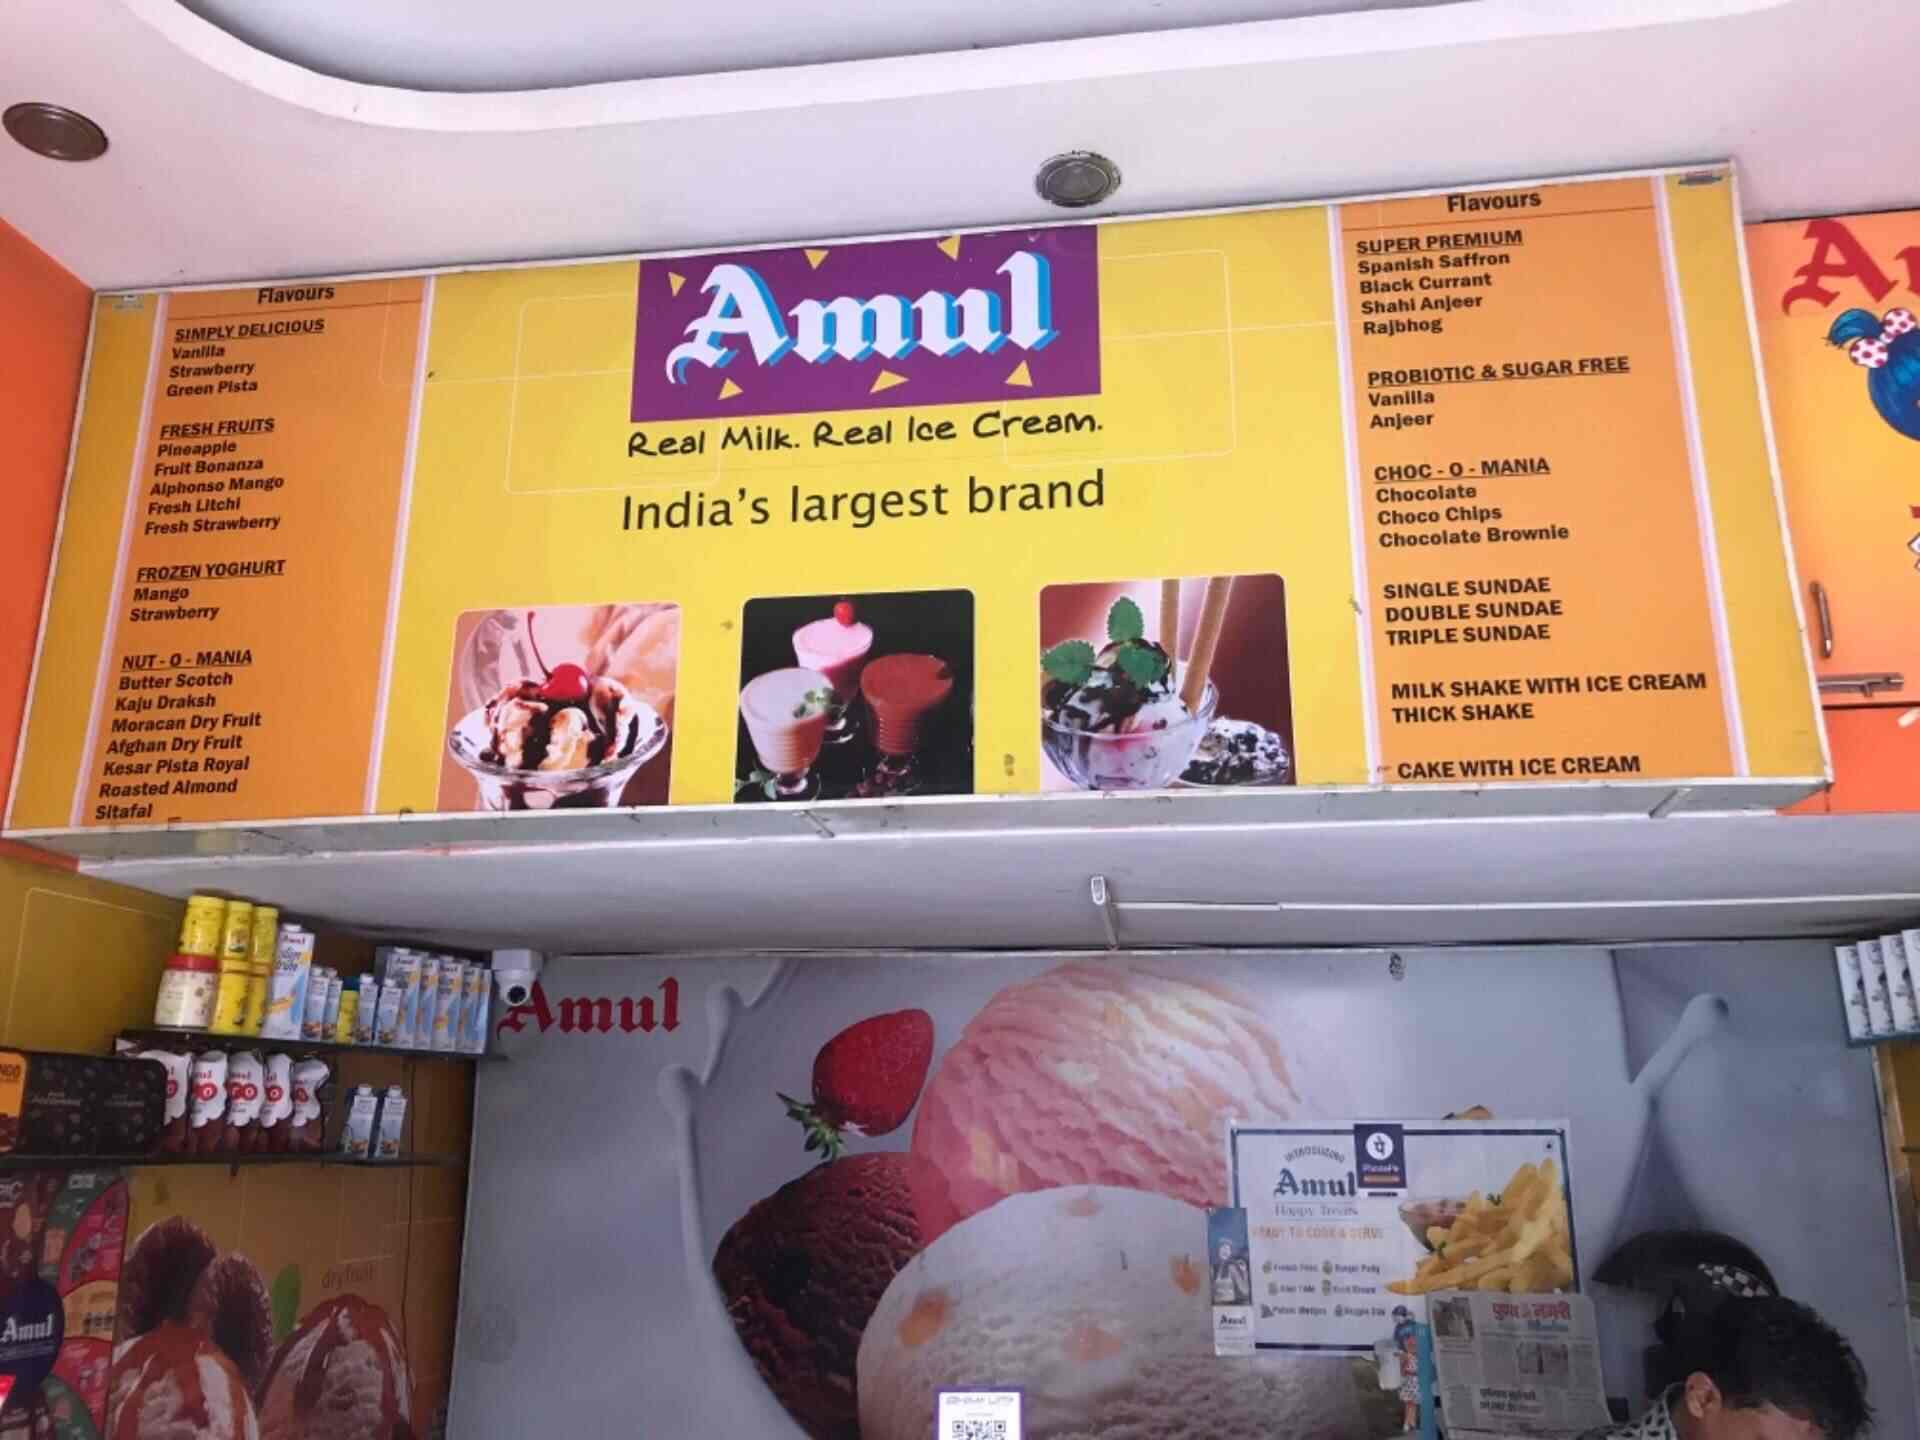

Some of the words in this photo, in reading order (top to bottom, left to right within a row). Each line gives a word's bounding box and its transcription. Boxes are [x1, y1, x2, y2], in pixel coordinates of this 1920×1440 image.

[1447, 192, 1542, 213] Flavours
[1357, 237, 1421, 255] SUPER
[1426, 229, 1523, 250] PREMIUM
[1358, 256, 1434, 276] Spanish
[1439, 251, 1511, 268] Saffron
[1360, 279, 1415, 295] Black
[1419, 273, 1492, 290] Currant
[257, 286, 335, 305] Flavours
[1361, 299, 1416, 315] Shahi
[1420, 294, 1484, 312] Anjeer
[665, 250, 1060, 384] Amul
[1363, 317, 1443, 337] Rajbhog
[174, 326, 235, 343] SIMPLY
[237, 318, 325, 338] DELICIOUS
[171, 345, 226, 361] Vanilla
[168, 362, 256, 379] Strawberry
[1367, 365, 1475, 387] PROBIOTIC
[1481, 364, 1497, 379] &
[1502, 359, 1573, 378] SUGAR
[1578, 356, 1630, 375] FREE
[166, 382, 214, 398] Green
[217, 378, 258, 394] Pista
[1368, 389, 1436, 408] Vanilla
[160, 422, 213, 440] FRESH
[216, 418, 275, 436] FRUITS
[1370, 412, 1434, 431] Anjeer
[627, 431, 705, 458] Real
[720, 426, 801, 452] Milk.
[813, 419, 893, 447] Real
[908, 415, 958, 441] Ice
[972, 409, 1104, 439] Cream.
[156, 440, 237, 458] Pineapple
[154, 461, 191, 477] Fruit
[195, 457, 264, 474] Bonanza
[1374, 463, 1432, 483] CHOC
[1449, 462, 1463, 479] O
[1481, 457, 1550, 476] MANIA
[150, 480, 224, 498] Alphonso
[228, 476, 285, 493] Mango
[1376, 484, 1478, 504] Chocolate
[148, 501, 192, 516] Fresh
[196, 498, 241, 513] Litchi
[623, 486, 770, 530] India's
[791, 482, 949, 529] largest
[969, 468, 1105, 515] brand
[144, 520, 189, 536] Fresh
[193, 516, 281, 533] Strawberry
[1377, 508, 1441, 526] Choco
[1445, 504, 1503, 522] Chips
[1379, 529, 1482, 549] Chocolate
[1487, 524, 1570, 543] Brownie
[136, 566, 201, 583] FROZEN
[205, 559, 286, 578] YOGHURT
[133, 586, 190, 603] Mango
[1383, 582, 1459, 600] SINGLE
[1464, 577, 1551, 596] SUNDAE
[129, 605, 220, 623] Strawberry
[1385, 604, 1470, 623] DOUBLE
[1475, 600, 1563, 619] SUNDAE
[1386, 628, 1458, 647] TRIPLE
[1463, 624, 1551, 643] SUNDAE
[121, 654, 158, 671] NUT
[169, 652, 182, 667] O
[196, 649, 253, 667] MANIA
[119, 675, 172, 691] Butter
[176, 671, 233, 688] Scotch
[1391, 682, 1446, 700] MILK
[1450, 679, 1522, 698] SHAKE
[1526, 677, 1581, 695] WITH
[1586, 675, 1623, 692] ICE
[1627, 672, 1707, 691] CREAM
[115, 697, 152, 713] Kaju
[156, 693, 216, 709] Draksh
[1392, 706, 1457, 724] THICK
[1462, 702, 1535, 721] SHAKE
[111, 717, 186, 734] Moracan
[190, 715, 218, 732] Dry
[222, 711, 262, 728] Fruit
[107, 737, 166, 757] Afghan
[170, 736, 199, 754] Dry
[203, 735, 243, 751] Fruit
[103, 760, 152, 777] Kesar
[156, 758, 199, 775] Pista
[203, 755, 250, 775] Royal
[1397, 761, 1454, 780] CAKE
[1459, 759, 1515, 777] WITH
[1520, 758, 1557, 775] ICE
[1561, 755, 1641, 774] CREAM
[99, 781, 169, 798] Roasted
[172, 778, 238, 795] Almond
[95, 803, 153, 820] Sitafal
[1273, 1167, 1357, 1198] Amul
[0, 1313, 54, 1344] Amul
